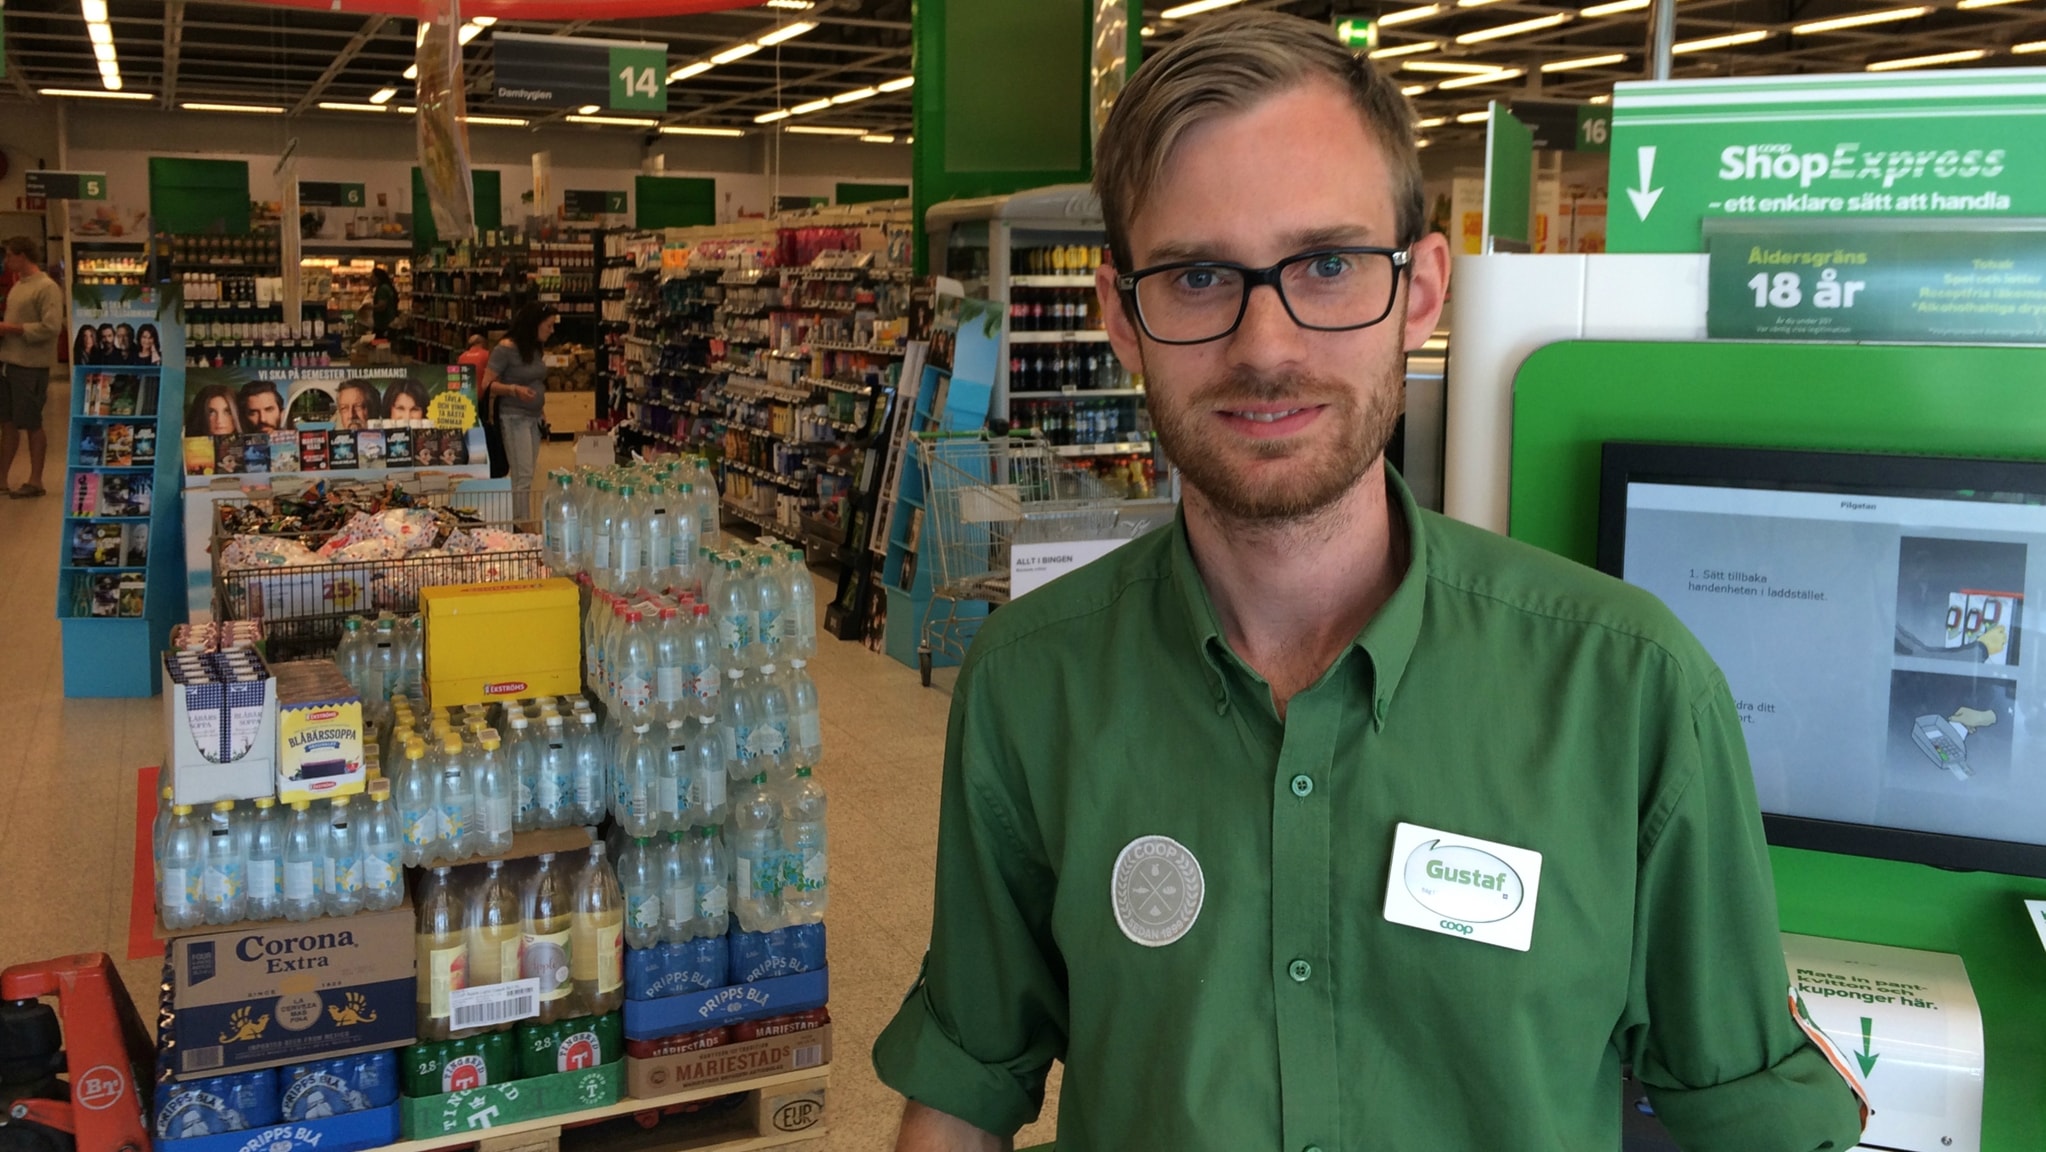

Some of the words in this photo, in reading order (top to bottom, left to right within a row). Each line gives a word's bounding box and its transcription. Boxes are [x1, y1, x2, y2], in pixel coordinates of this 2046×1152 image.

[619, 66, 659, 98] 14
[1582, 118, 1607, 144] 16
[87, 181, 99, 196] 5
[348, 190, 359, 203] 6
[613, 198, 622, 209] 7
[1724, 195, 1756, 212] ett
[1758, 193, 1844, 212] enklare
[1847, 192, 1895, 212] sätt
[1896, 193, 1929, 211] att
[1931, 191, 2010, 211] handla
[1748, 246, 1868, 267] Åldersgräns
[1748, 272, 1802, 308] 18
[1813, 268, 1866, 308] år
[258, 370, 268, 380] VI
[269, 370, 287, 380] SKA
[288, 367, 300, 379] PÅ
[301, 369, 345, 379] SEMESTER
[347, 368, 407, 379] TILLSAMMANS!
[1016, 557, 1036, 565] ALLT
[1042, 555, 1073, 564] BINGEN
[1703, 569, 1725, 581] Sätt
[1728, 571, 1767, 584] tillbaka
[1688, 581, 1758, 596] handenheten
[1767, 587, 1828, 601] laddstället.
[490, 682, 525, 694] EKSTRÖMS
[1757, 702, 1776, 713] ditt
[288, 728, 357, 749] BLÅBÄRSSOPPA
[1134, 842, 1178, 859] COOP
[1426, 859, 1507, 892] Gustaf
[1127, 920, 1159, 940] SEDAN
[1440, 919, 1473, 935] coop
[236, 930, 354, 962] Corona
[266, 955, 329, 974] Extra
[746, 957, 786, 983] PRIPPS
[789, 958, 809, 973] BLÅ
[646, 970, 689, 998] PRIPPS
[691, 971, 712, 989] BLÅ
[1797, 968, 1846, 981] Mata
[1851, 975, 1870, 984] in
[1875, 980, 1928, 991] pant-
[1797, 975, 1871, 991] kvitton
[1876, 986, 1914, 996] och
[698, 987, 744, 1018] PRIPPS
[746, 987, 770, 1007] BLÅ
[1798, 983, 1896, 1004] kuponger
[1901, 996, 1938, 1010] här.
[560, 1033, 599, 1057] TINGSRYD
[444, 1057, 485, 1080] TINGSRYD
[676, 1045, 791, 1082] MARIESTADS
[783, 1104, 812, 1128] EUR
[296, 1127, 322, 1147] BLÅ
